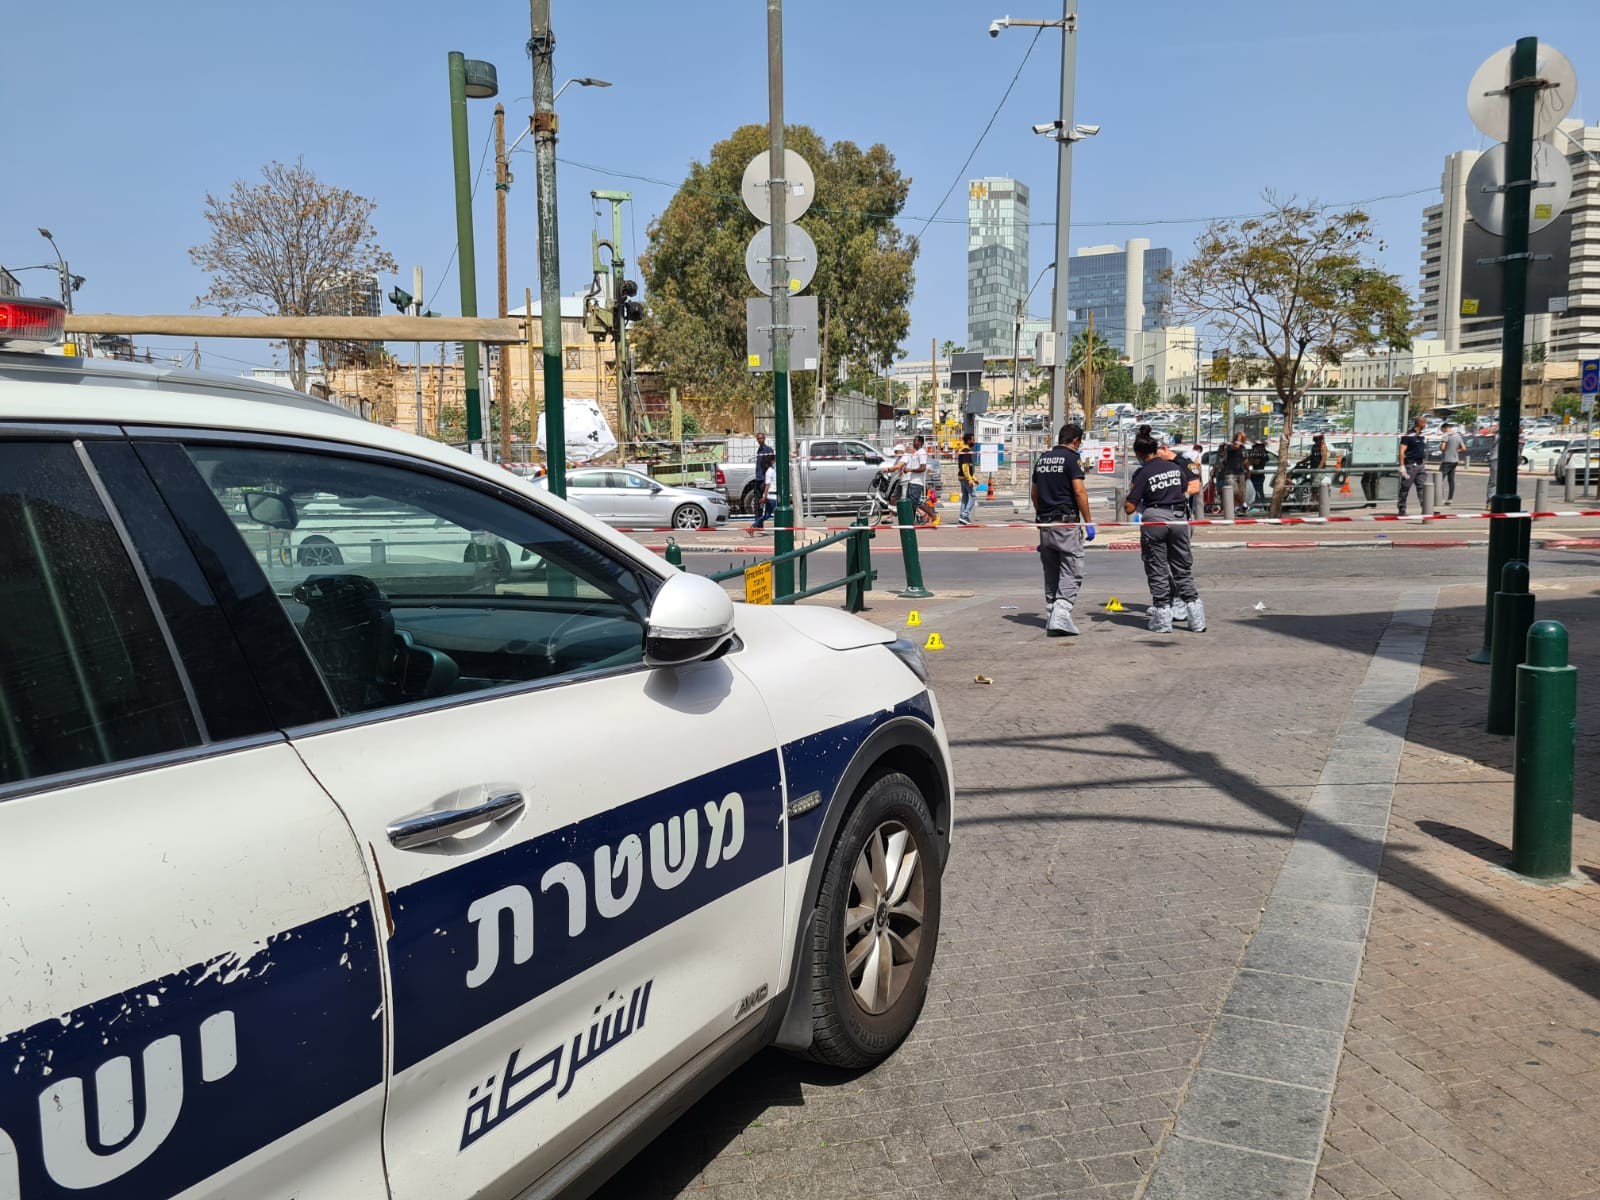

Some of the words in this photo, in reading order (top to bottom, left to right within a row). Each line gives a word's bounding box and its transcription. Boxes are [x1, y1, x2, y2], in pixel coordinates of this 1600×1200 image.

[1036, 465, 1064, 473] POLICE
[1148, 470, 1181, 485] משטרה
[466, 792, 744, 988] משטרת
[734, 982, 769, 1020] AWD
[459, 978, 654, 1151] الشرطة
